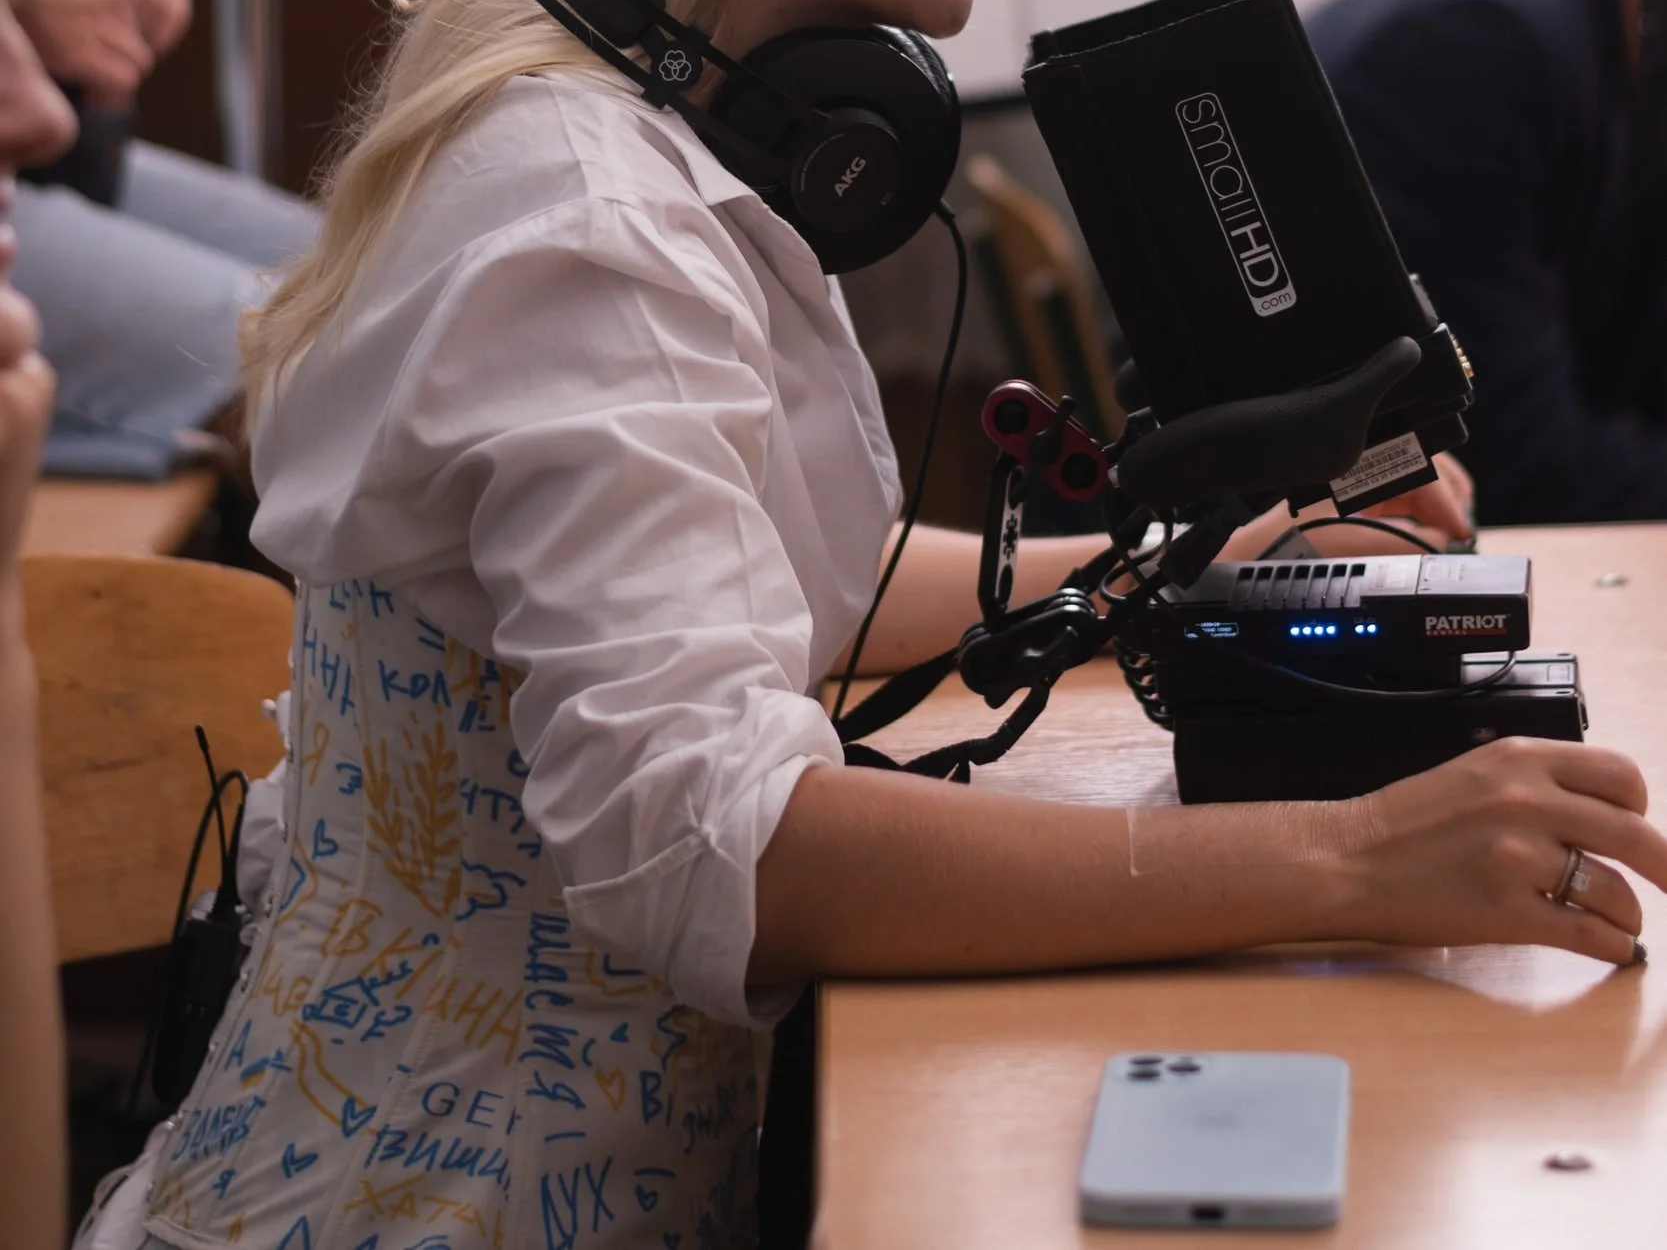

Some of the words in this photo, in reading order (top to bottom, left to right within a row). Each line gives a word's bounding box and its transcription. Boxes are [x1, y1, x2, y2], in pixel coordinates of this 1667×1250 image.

[833, 156, 867, 197] AKG
[1182, 99, 1280, 287] smallHD
[1425, 615, 1507, 630] PATRIOT
